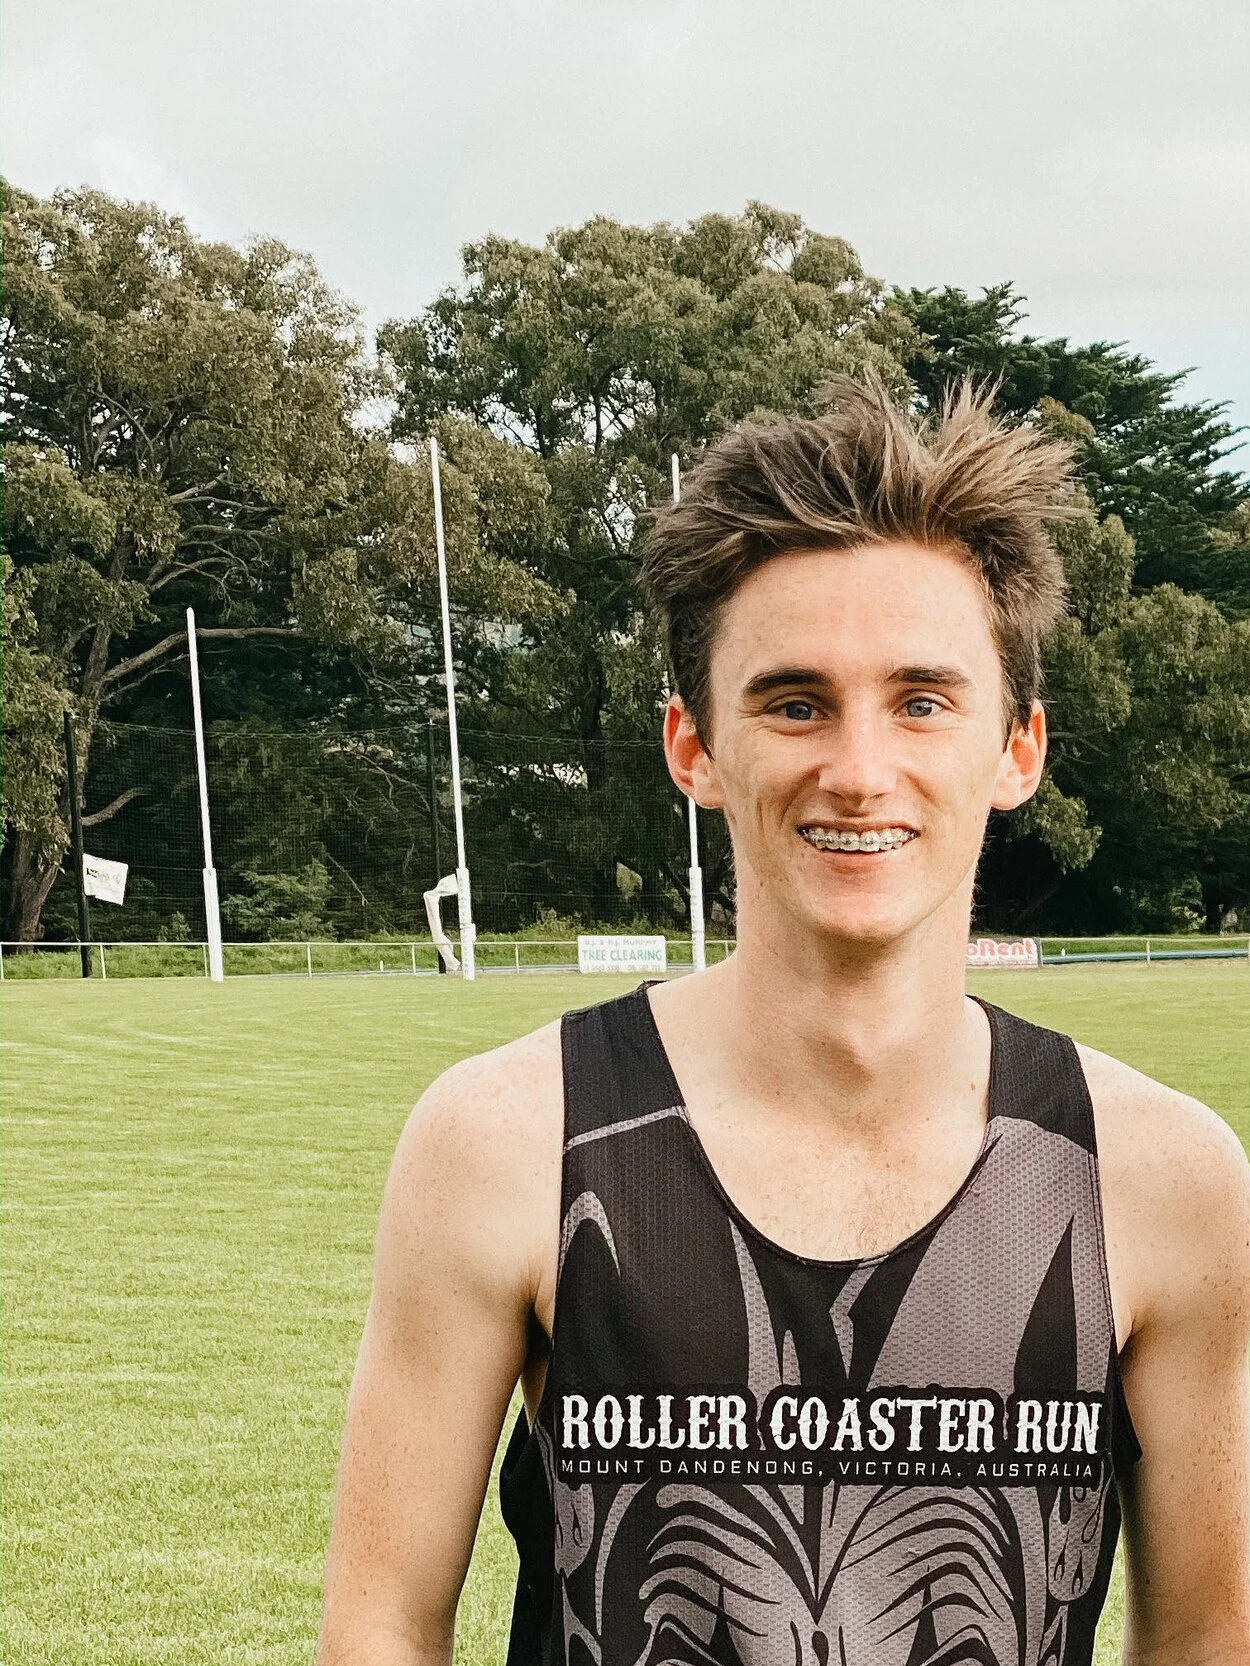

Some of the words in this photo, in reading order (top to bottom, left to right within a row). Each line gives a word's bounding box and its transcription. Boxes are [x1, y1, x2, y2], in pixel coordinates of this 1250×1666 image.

[582, 950, 606, 961] TREE
[610, 949, 663, 961] CLEARING
[561, 1394, 748, 1451] ROLLER
[769, 1395, 995, 1453] COASTER
[1015, 1399, 1102, 1456] RUN
[561, 1459, 644, 1475] MOUNT
[659, 1460, 823, 1478] DANDENONG,
[840, 1461, 962, 1479] VICTORIA,
[976, 1464, 1094, 1479] AUSTRALIA
